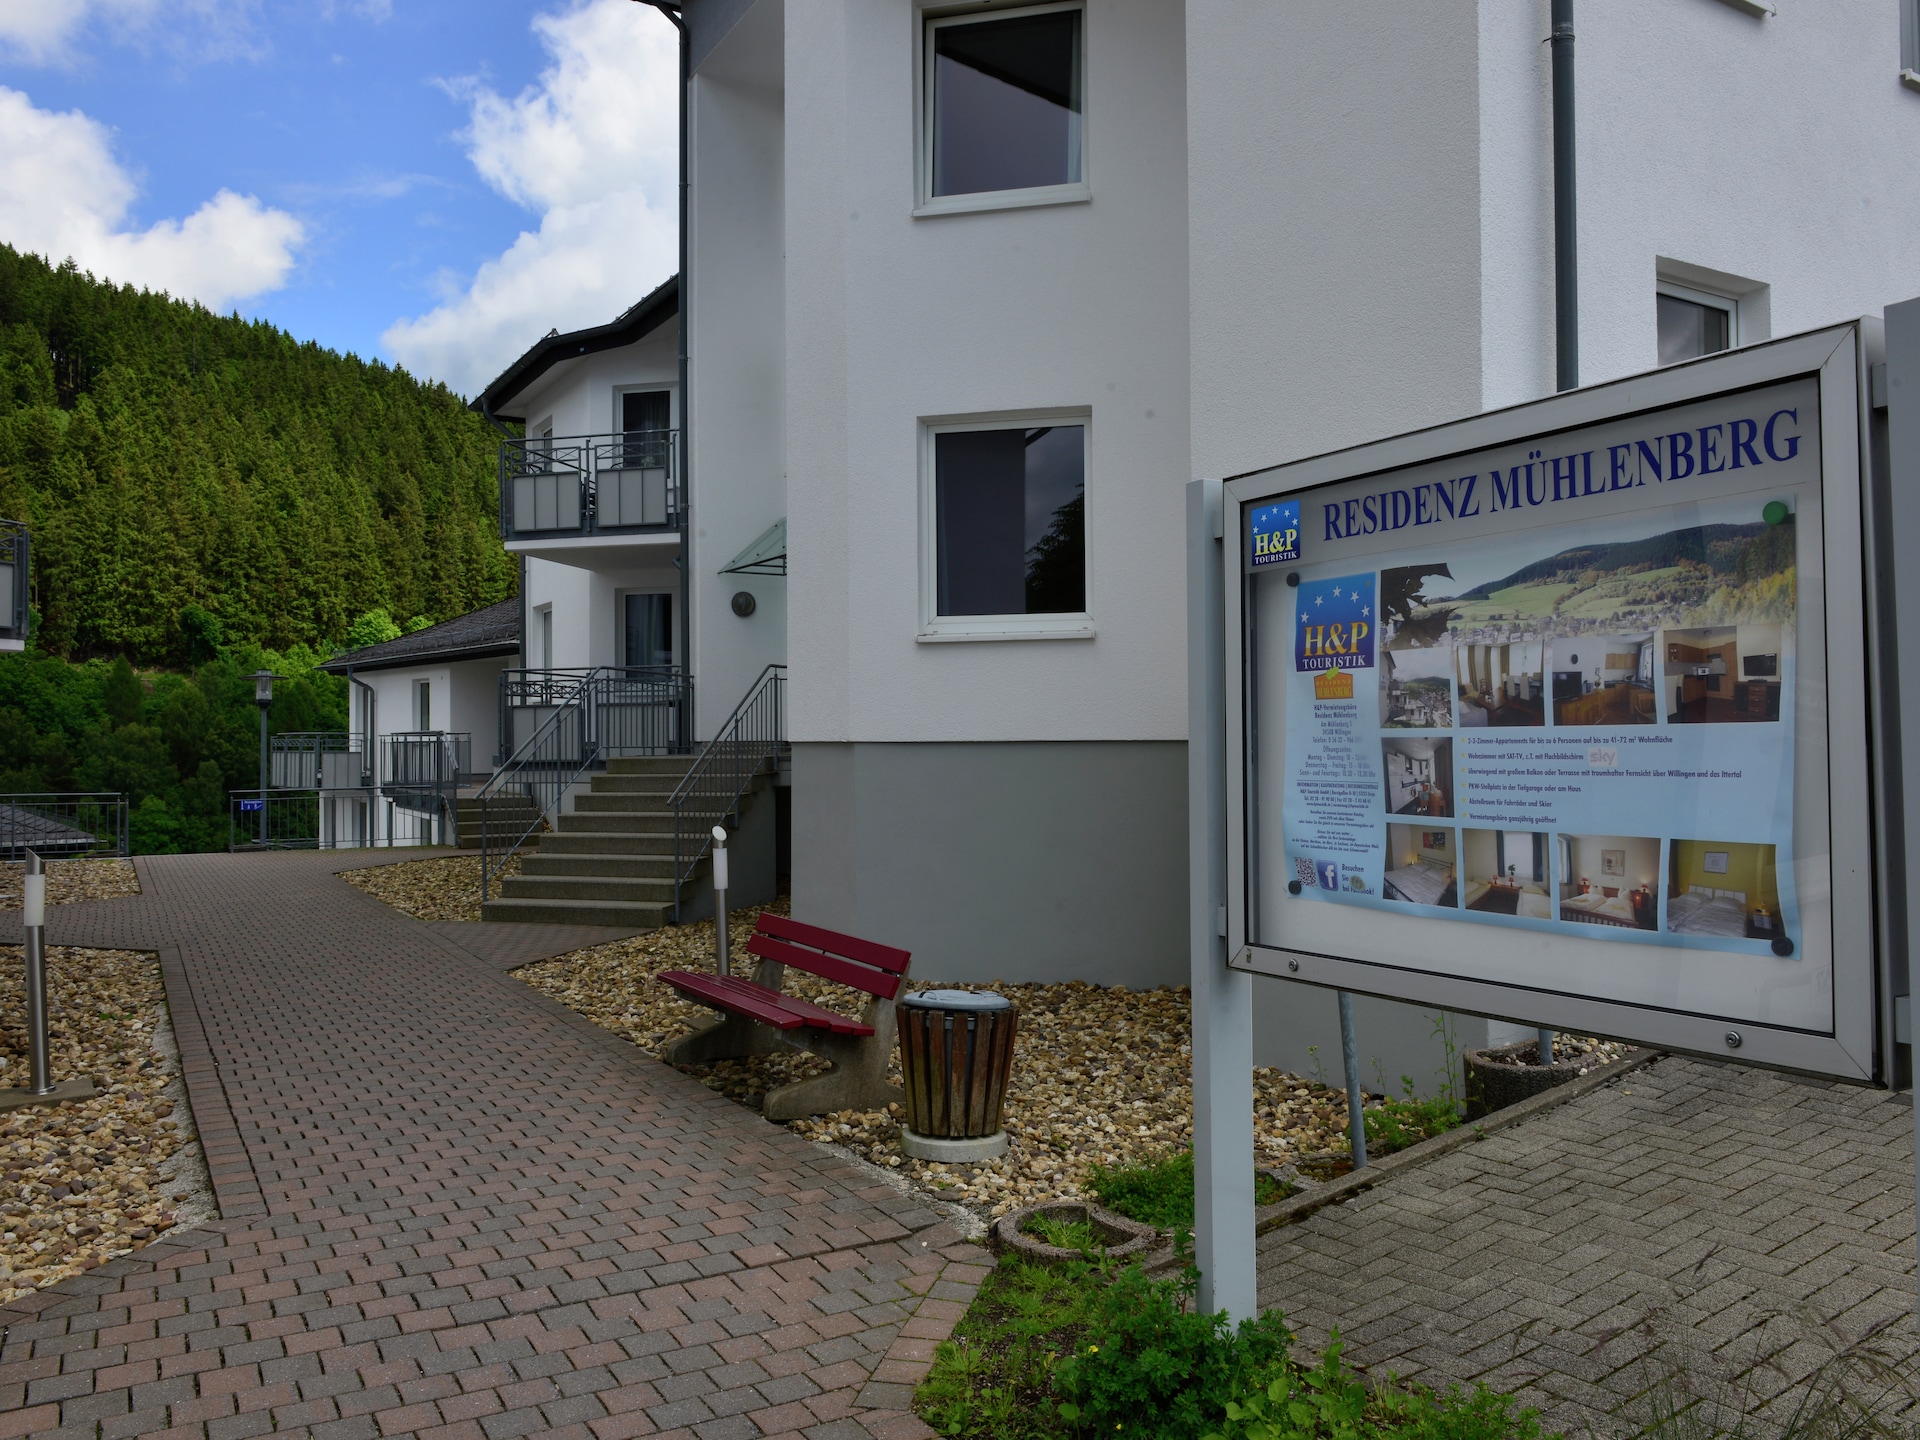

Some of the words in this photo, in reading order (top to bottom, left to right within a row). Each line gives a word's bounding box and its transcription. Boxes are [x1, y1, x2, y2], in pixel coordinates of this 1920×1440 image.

[1323, 474, 1480, 541] RESIDENZ
[1489, 408, 1802, 513] MÜHLENBERG
[1254, 528, 1297, 556] H&P
[1254, 551, 1297, 564] TOURISTIK
[1304, 622, 1369, 656] H&P
[1302, 655, 1366, 669] TOURISTIK
[1468, 737, 1528, 746] 2-3-Zimmer-Appartements
[1589, 748, 1616, 765] sky
[1468, 768, 1498, 776] überwiegend
[1507, 769, 1525, 777] großem
[1667, 770, 1696, 779] Willingen
[1468, 783, 1501, 791] PKW-Stellplatz
[1517, 784, 1543, 793] Tiefgarage
[1469, 813, 1507, 822] Vermietungsbüro
[1508, 814, 1534, 824] ganzjährig
[1342, 864, 1364, 873] Besuchen
